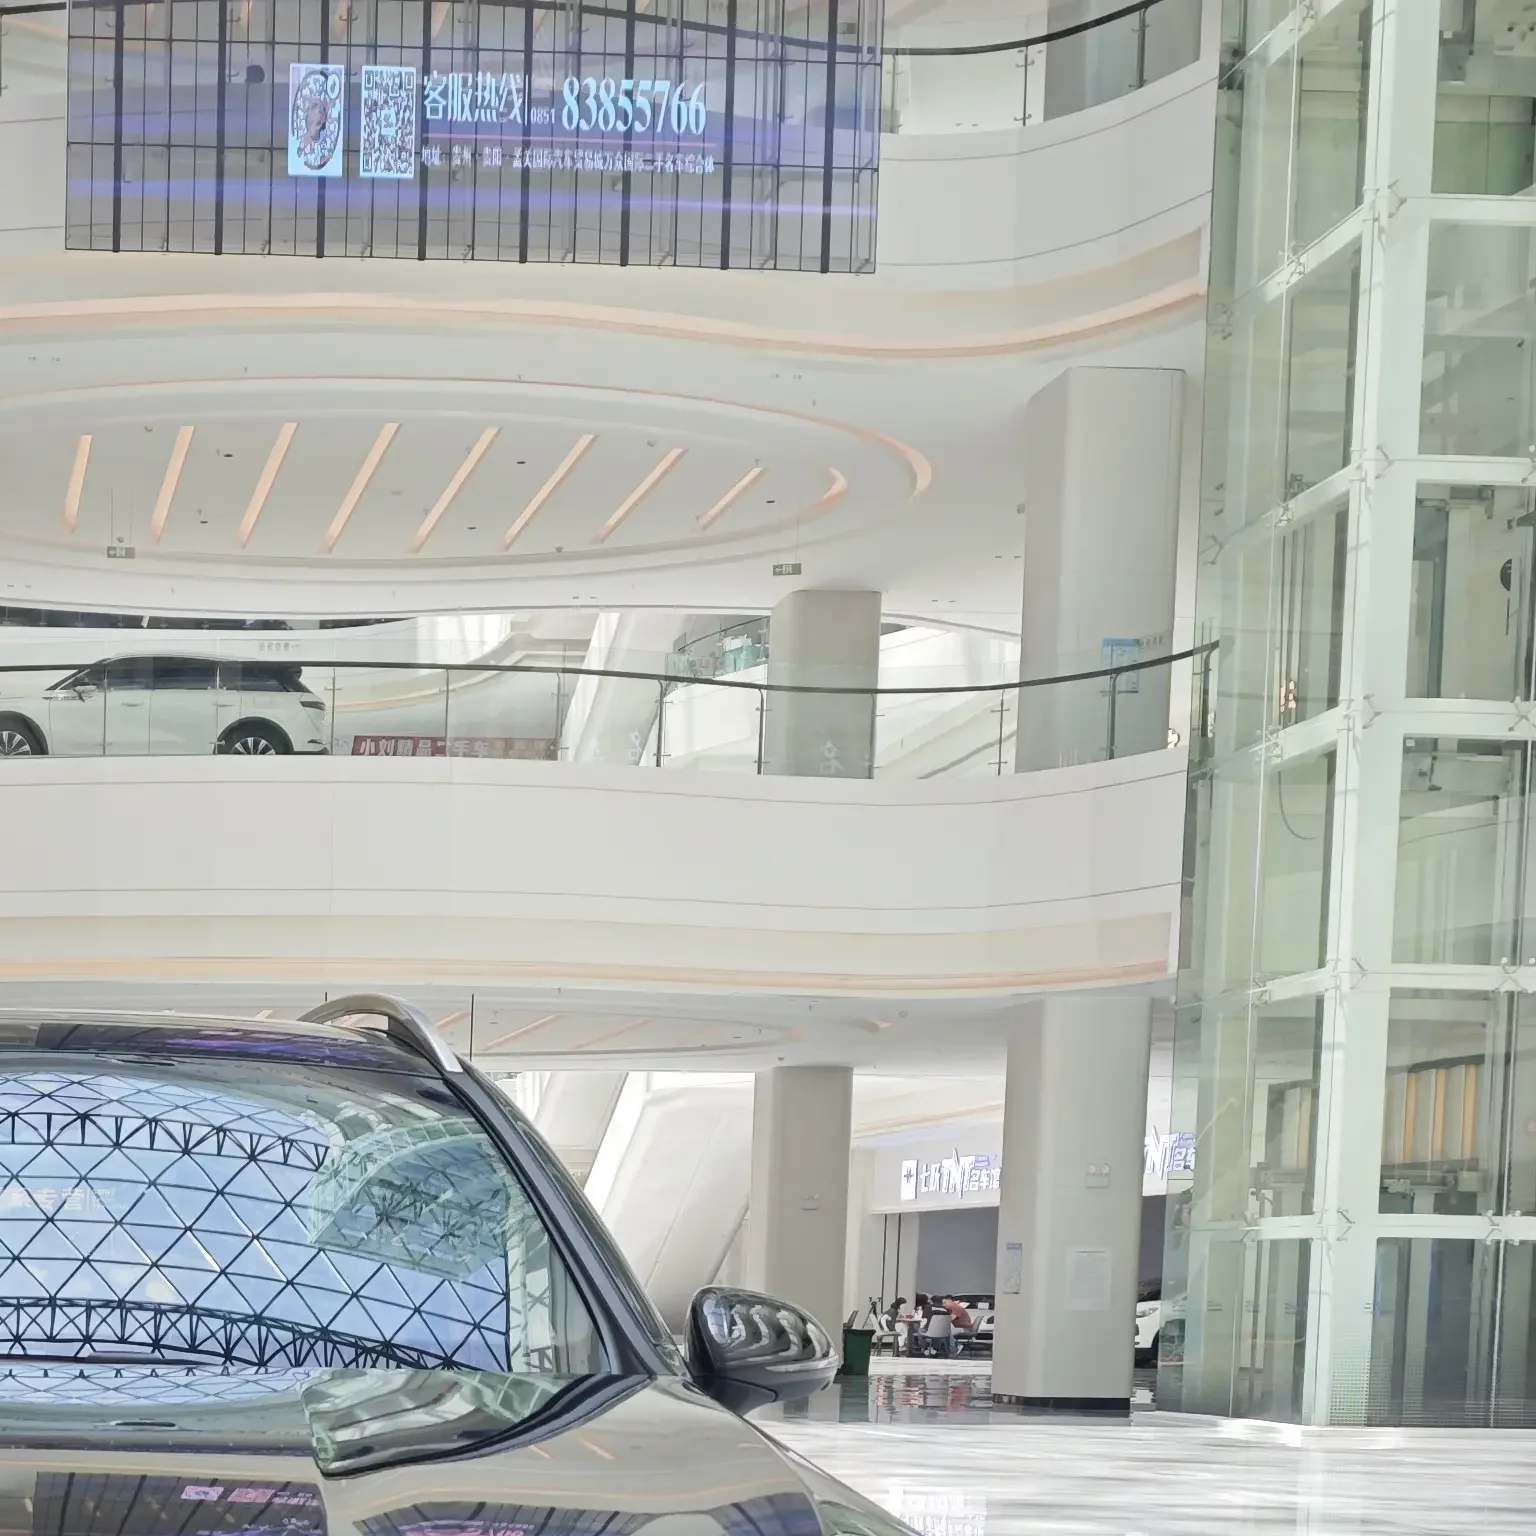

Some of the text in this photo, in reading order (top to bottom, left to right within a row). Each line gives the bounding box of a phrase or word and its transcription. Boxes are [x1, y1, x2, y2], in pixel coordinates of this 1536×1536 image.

[423, 70, 707, 135] 客服热线 0851 83855766
